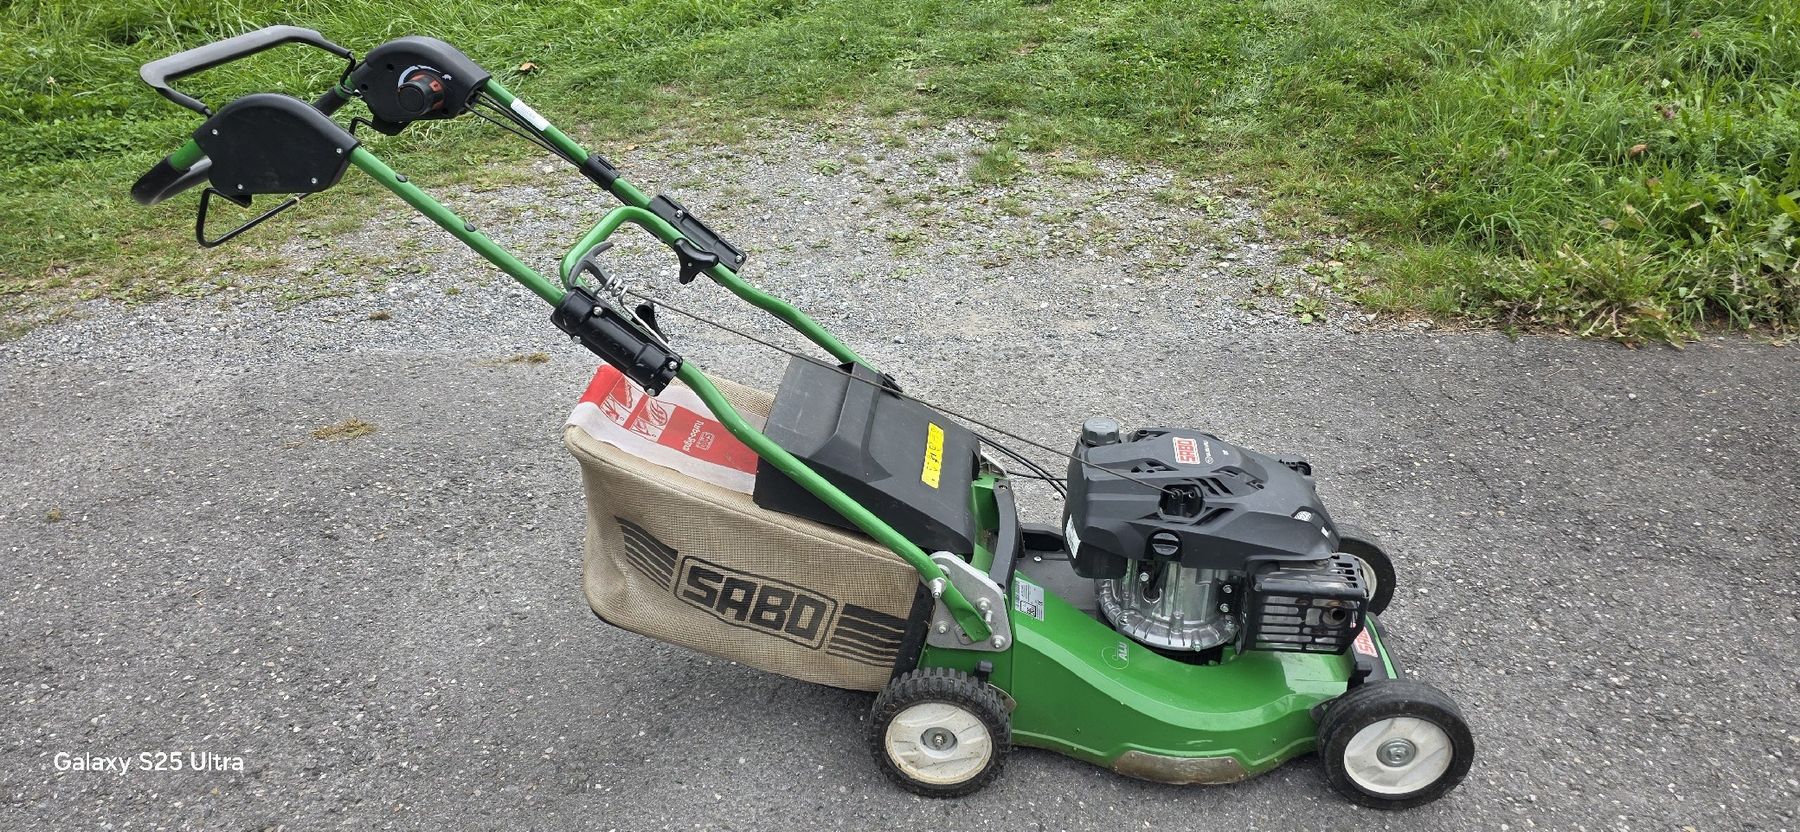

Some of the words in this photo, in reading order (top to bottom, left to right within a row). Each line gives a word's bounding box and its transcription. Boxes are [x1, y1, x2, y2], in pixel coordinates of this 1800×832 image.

[1178, 438, 1199, 463] SABO
[683, 566, 828, 641] SABO
[1118, 641, 1128, 662] ALU
